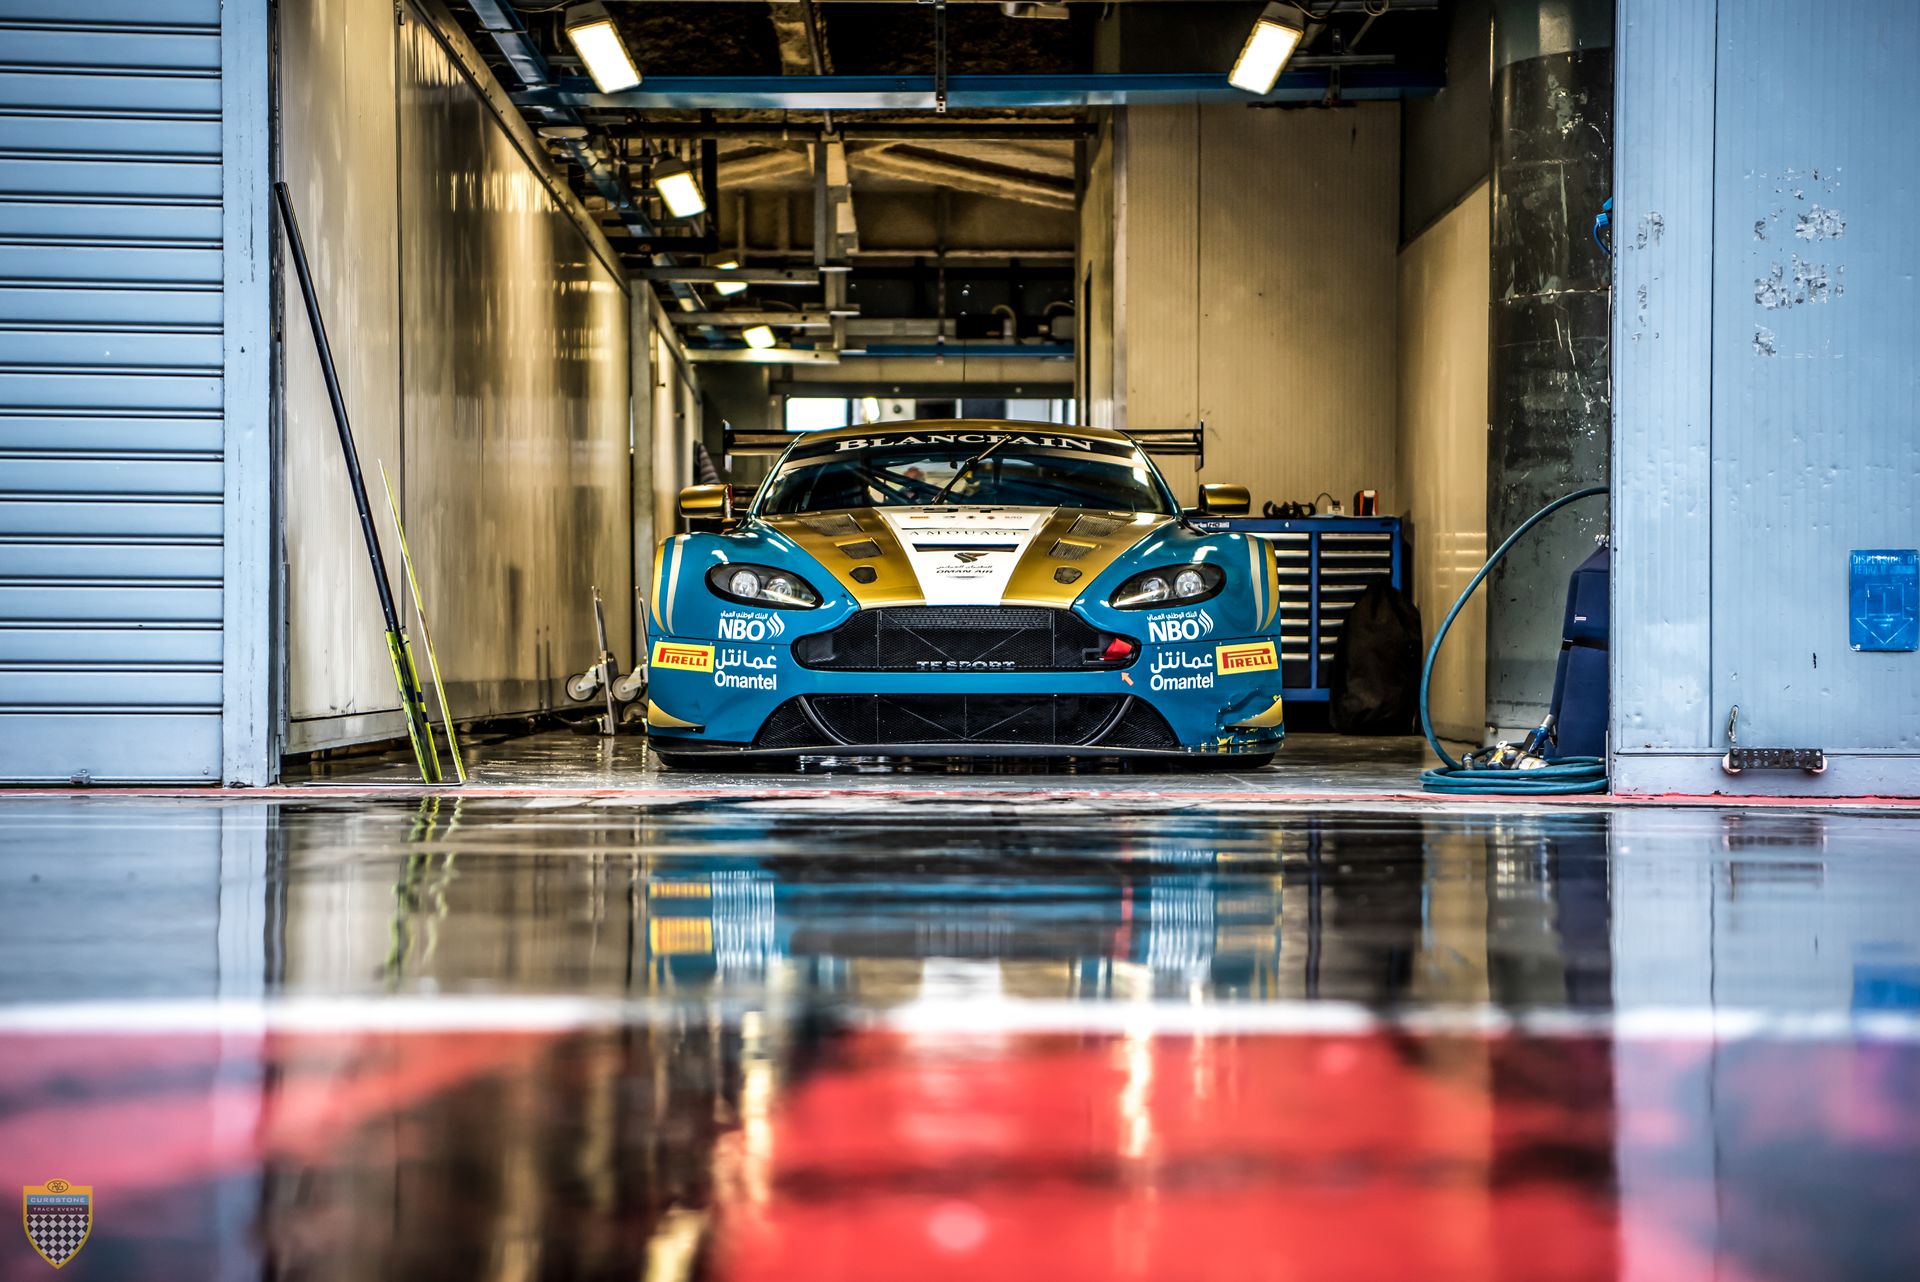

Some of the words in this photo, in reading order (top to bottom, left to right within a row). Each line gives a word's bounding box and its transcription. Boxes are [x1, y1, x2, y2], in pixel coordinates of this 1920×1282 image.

[835, 434, 1093, 452] BLANCPAIN
[718, 618, 766, 641] NBO
[1148, 619, 1200, 642] NBO
[658, 647, 709, 667] PIRELLI
[1221, 648, 1273, 669] PIRELLI
[714, 670, 777, 690] Omantel
[1150, 672, 1214, 691] Omantel
